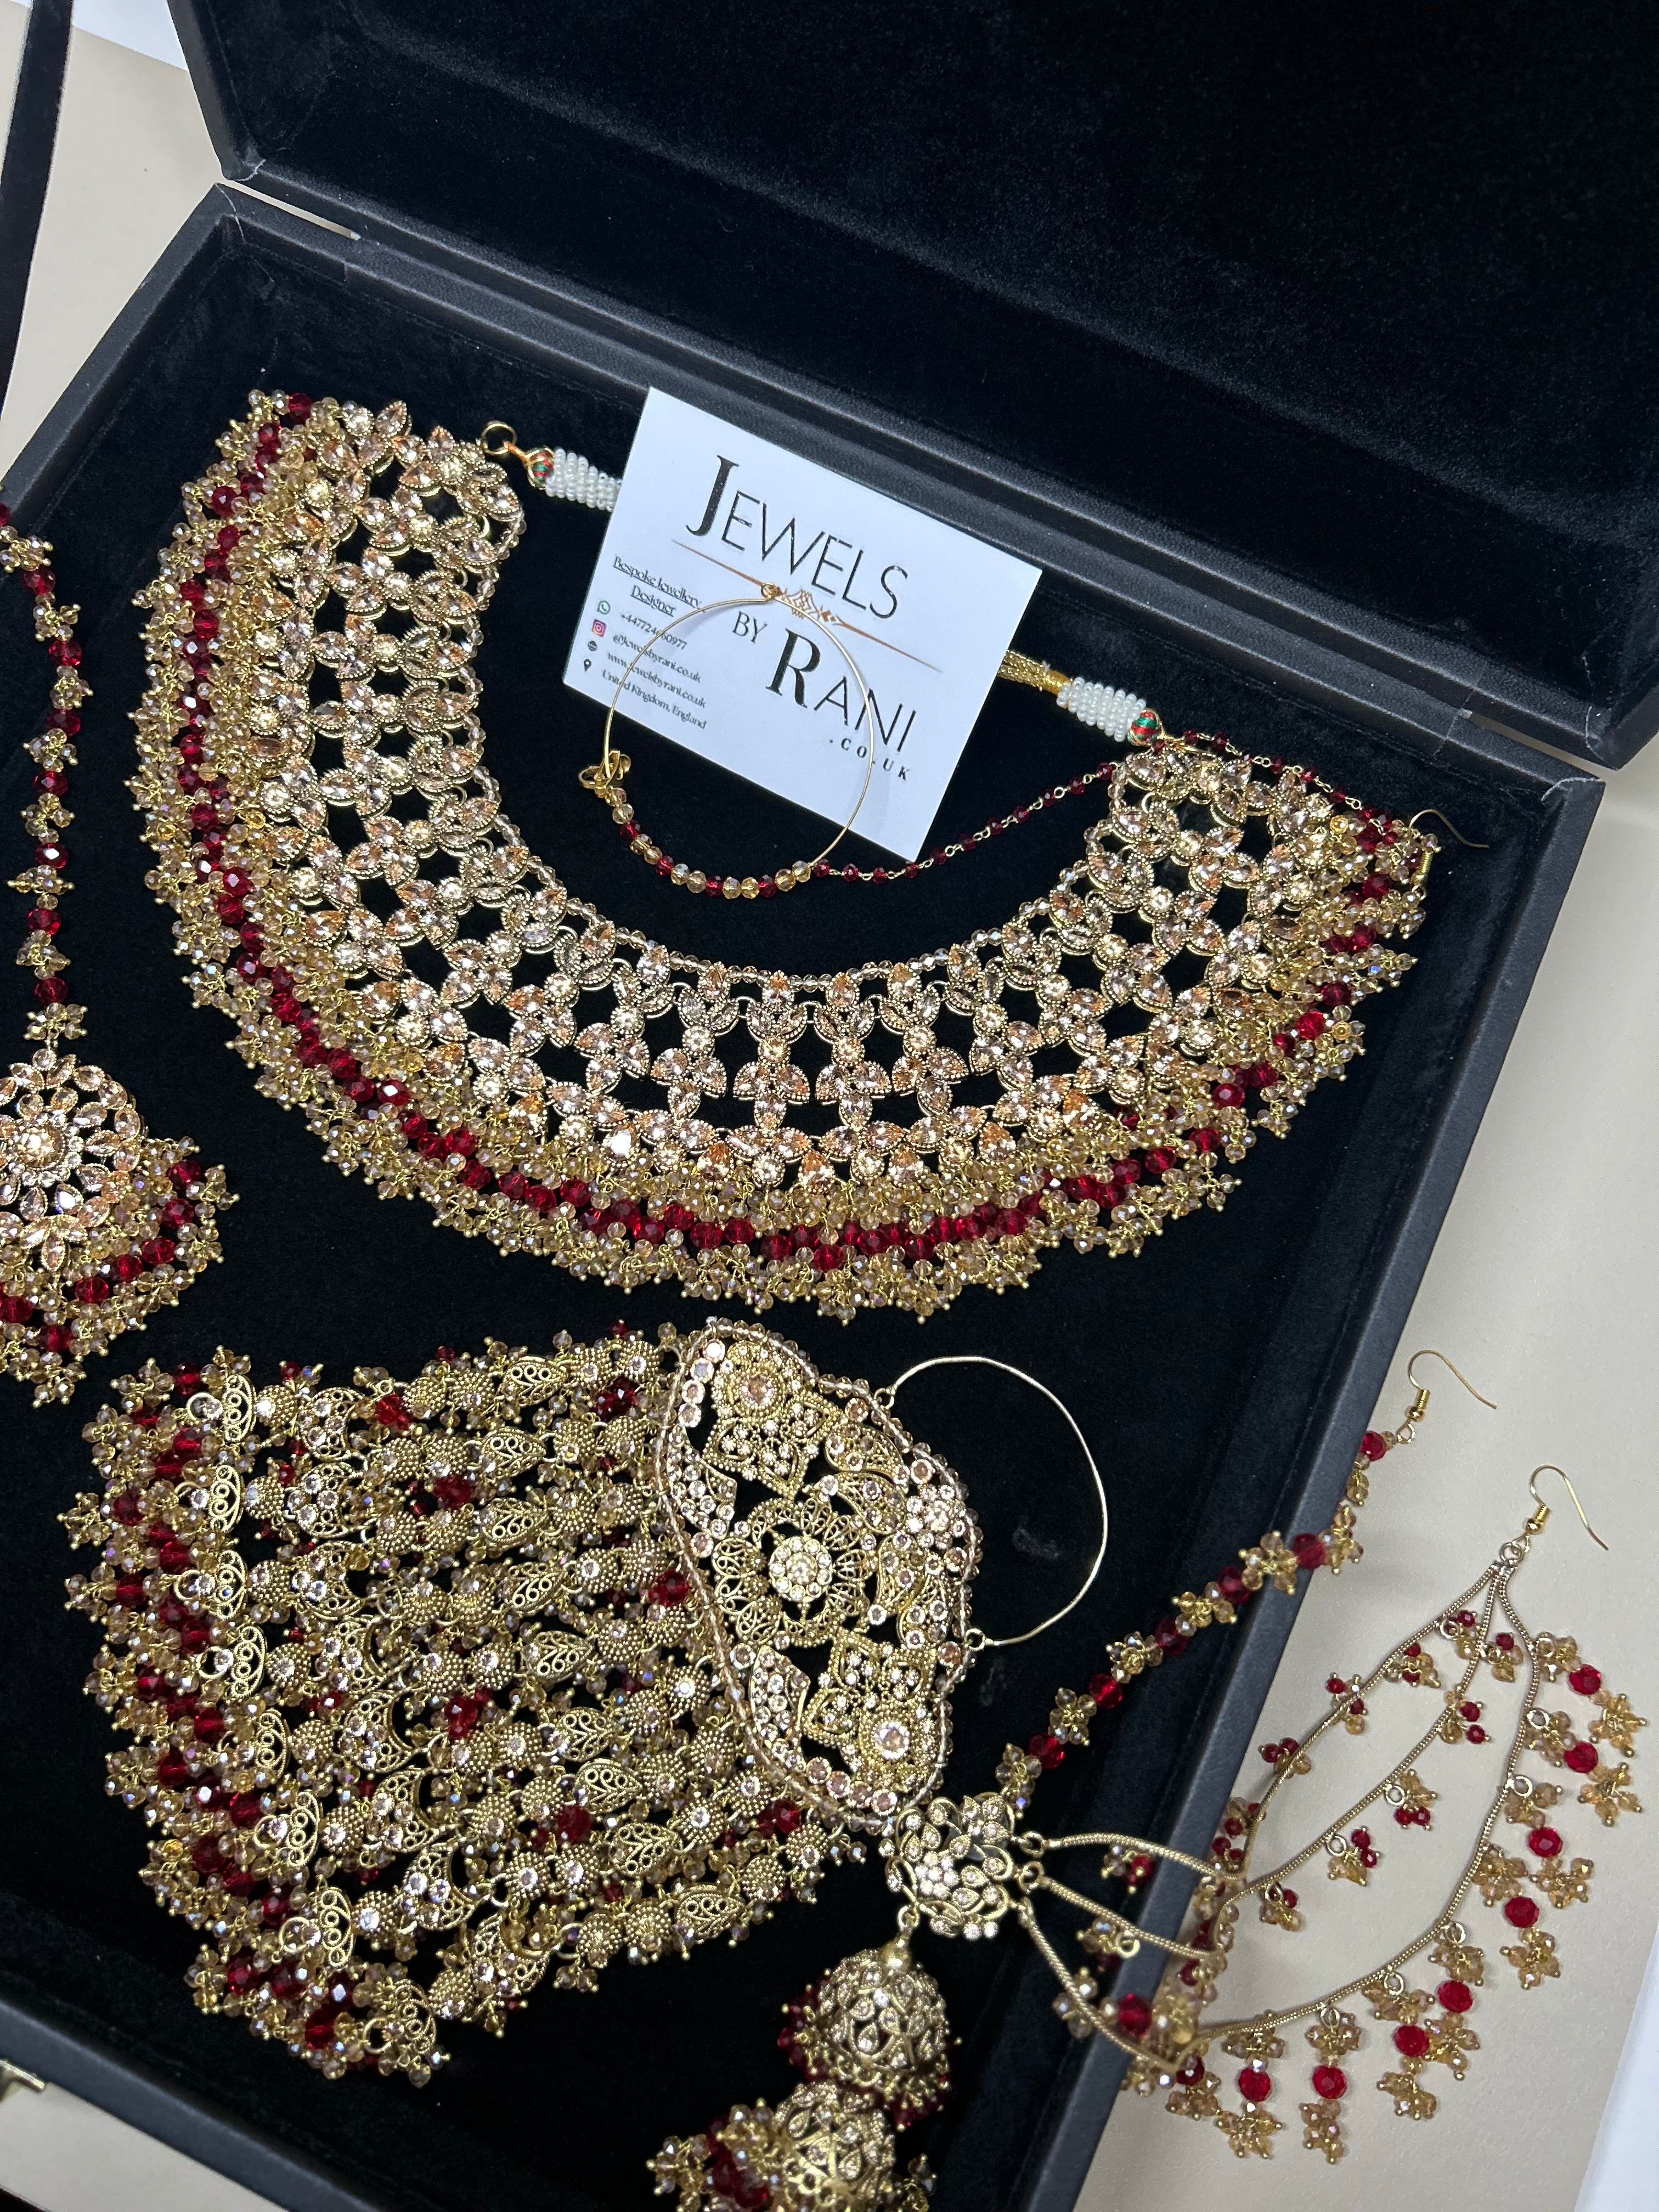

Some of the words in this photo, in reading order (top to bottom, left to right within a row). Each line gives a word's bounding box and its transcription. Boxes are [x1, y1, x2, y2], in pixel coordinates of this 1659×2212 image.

[686, 454, 909, 619] JEWELS
[613, 556, 656, 586] Bespoke
[657, 577, 702, 611] Jewellery
[630, 584, 676, 617] Designer
[602, 669, 631, 691] Unitd
[631, 684, 670, 712] Kingdom,
[672, 704, 707, 729] England
[607, 652, 707, 708] www.ewelsbyrani.co.uk
[732, 611, 768, 644] BY
[765, 628, 917, 752] RANI
